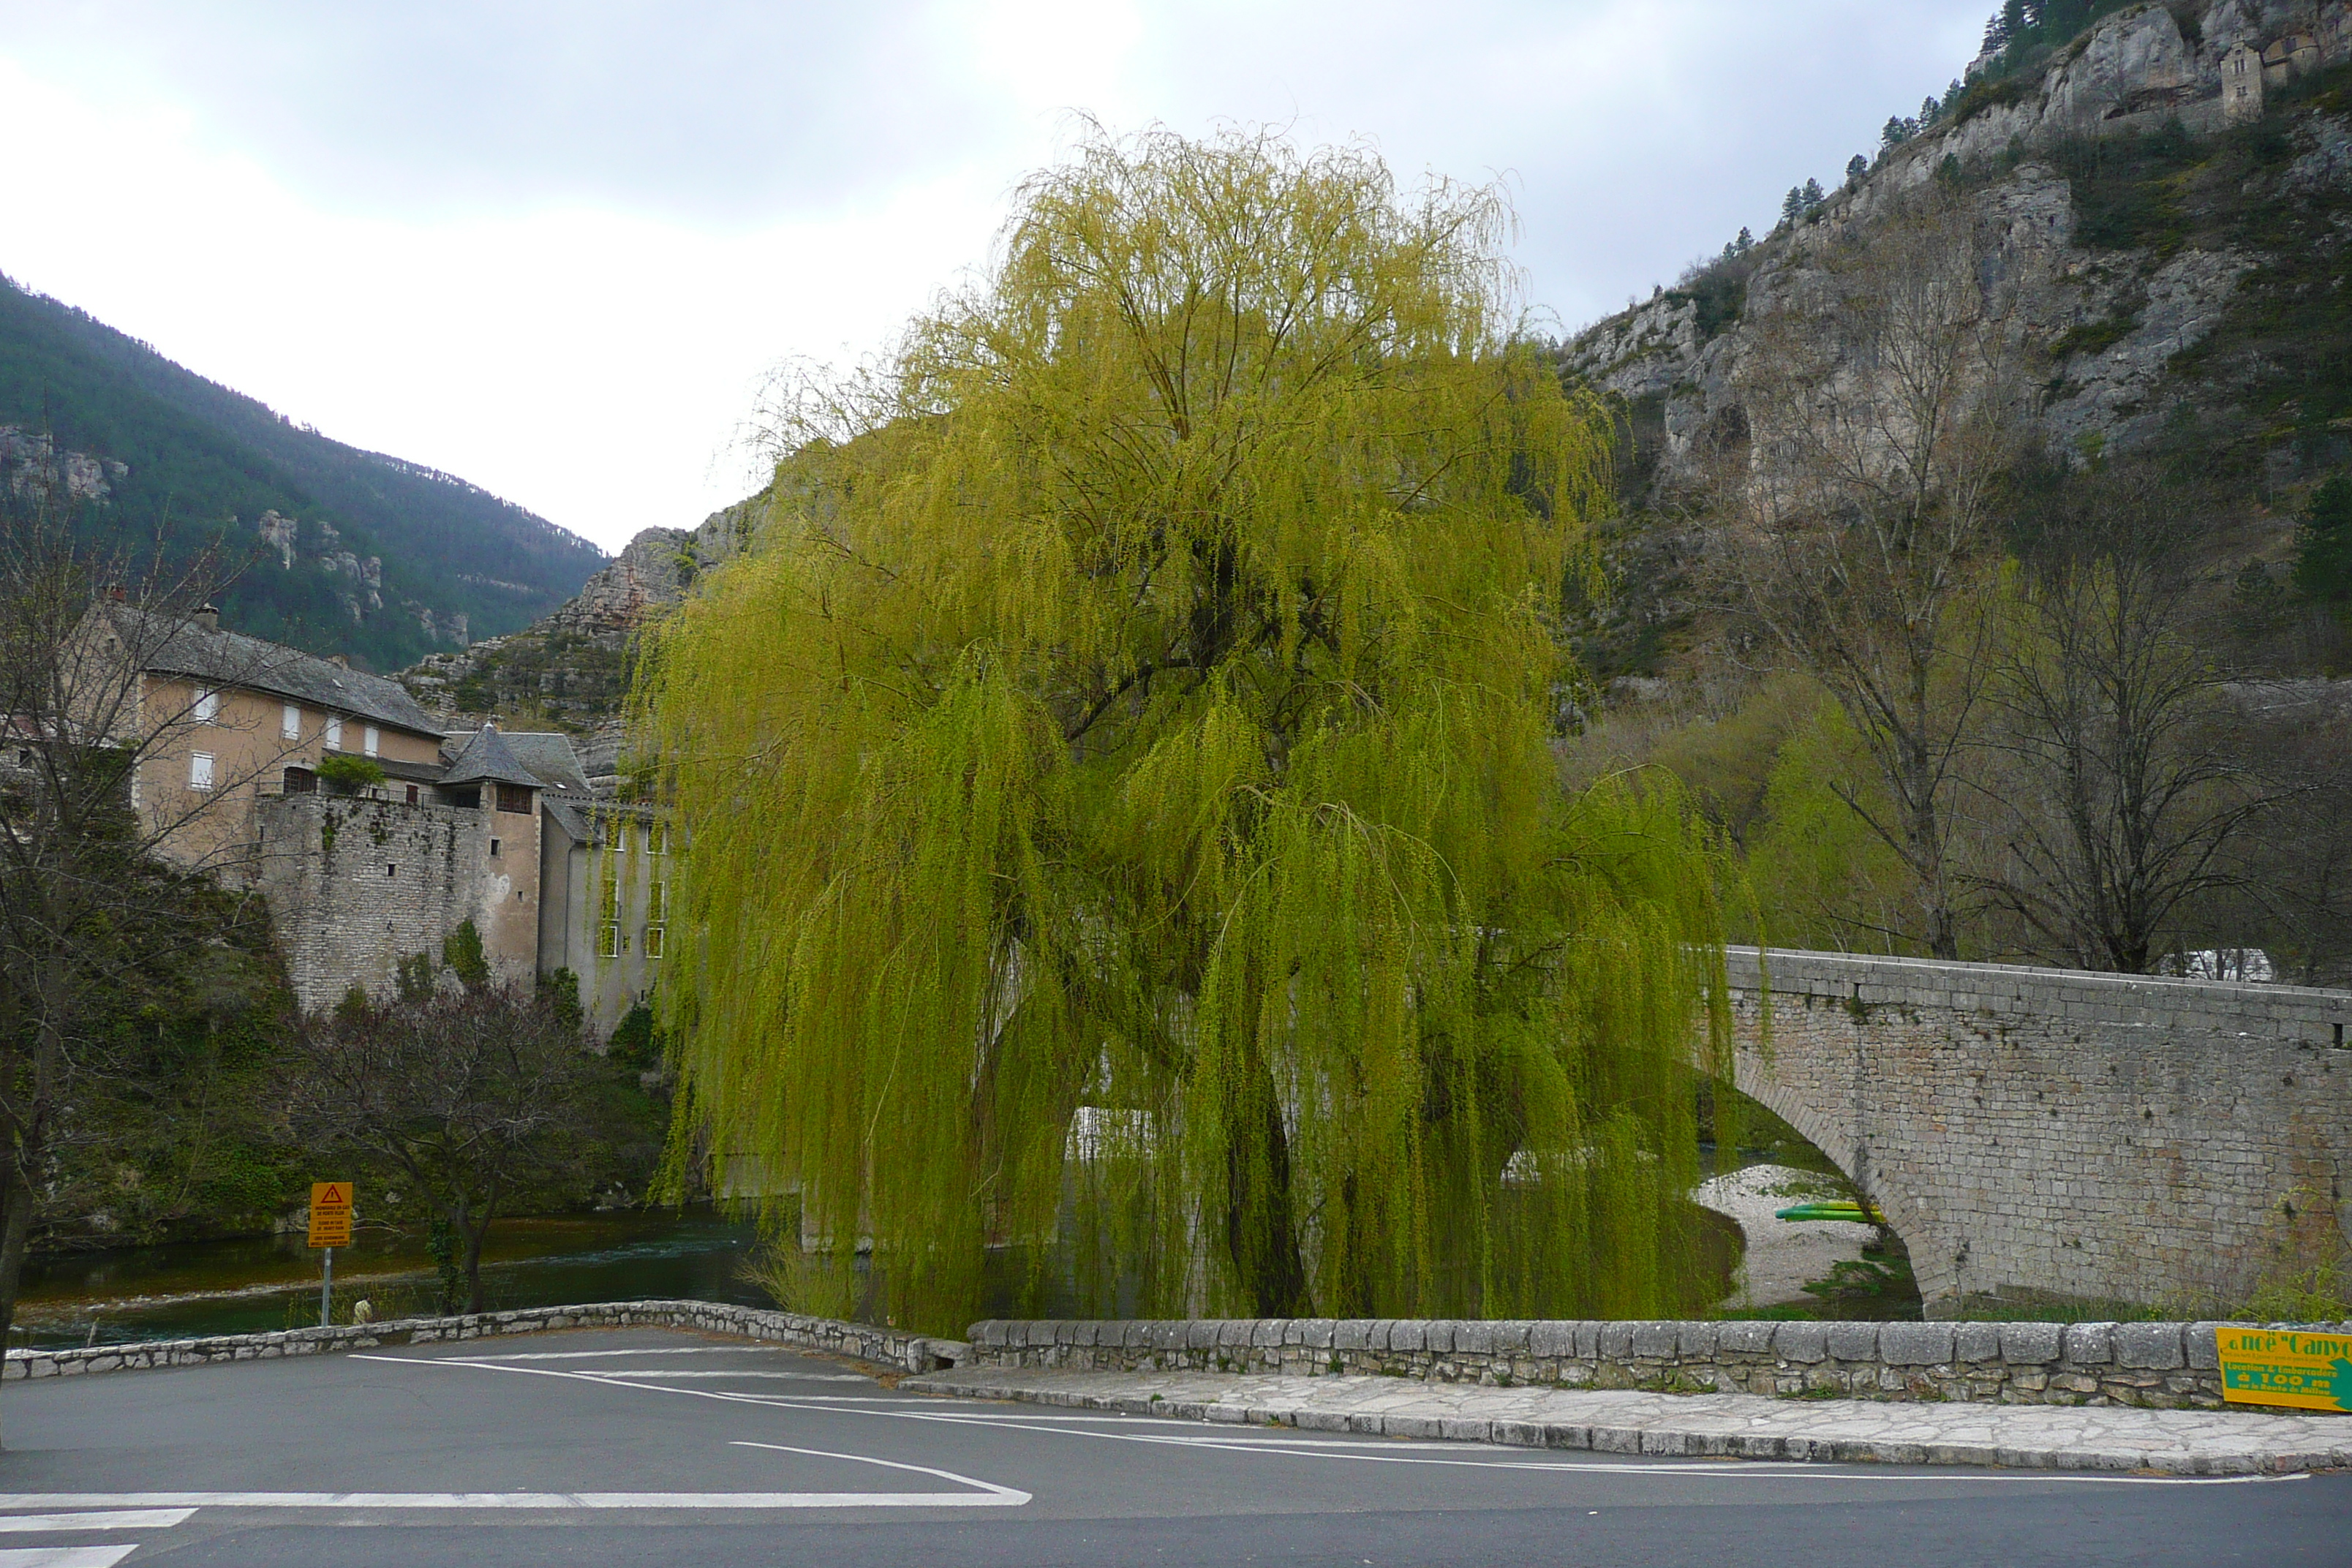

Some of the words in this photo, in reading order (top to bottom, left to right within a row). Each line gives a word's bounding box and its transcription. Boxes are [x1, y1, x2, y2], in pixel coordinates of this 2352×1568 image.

[2227, 1362, 2265, 1372] Location
[2267, 1365, 2275, 1373] &
[2237, 1371, 2250, 1382] à
[2261, 1373, 2304, 1386] 100
[2311, 1379, 2331, 1388] m
[2260, 1383, 2288, 1392] Route
